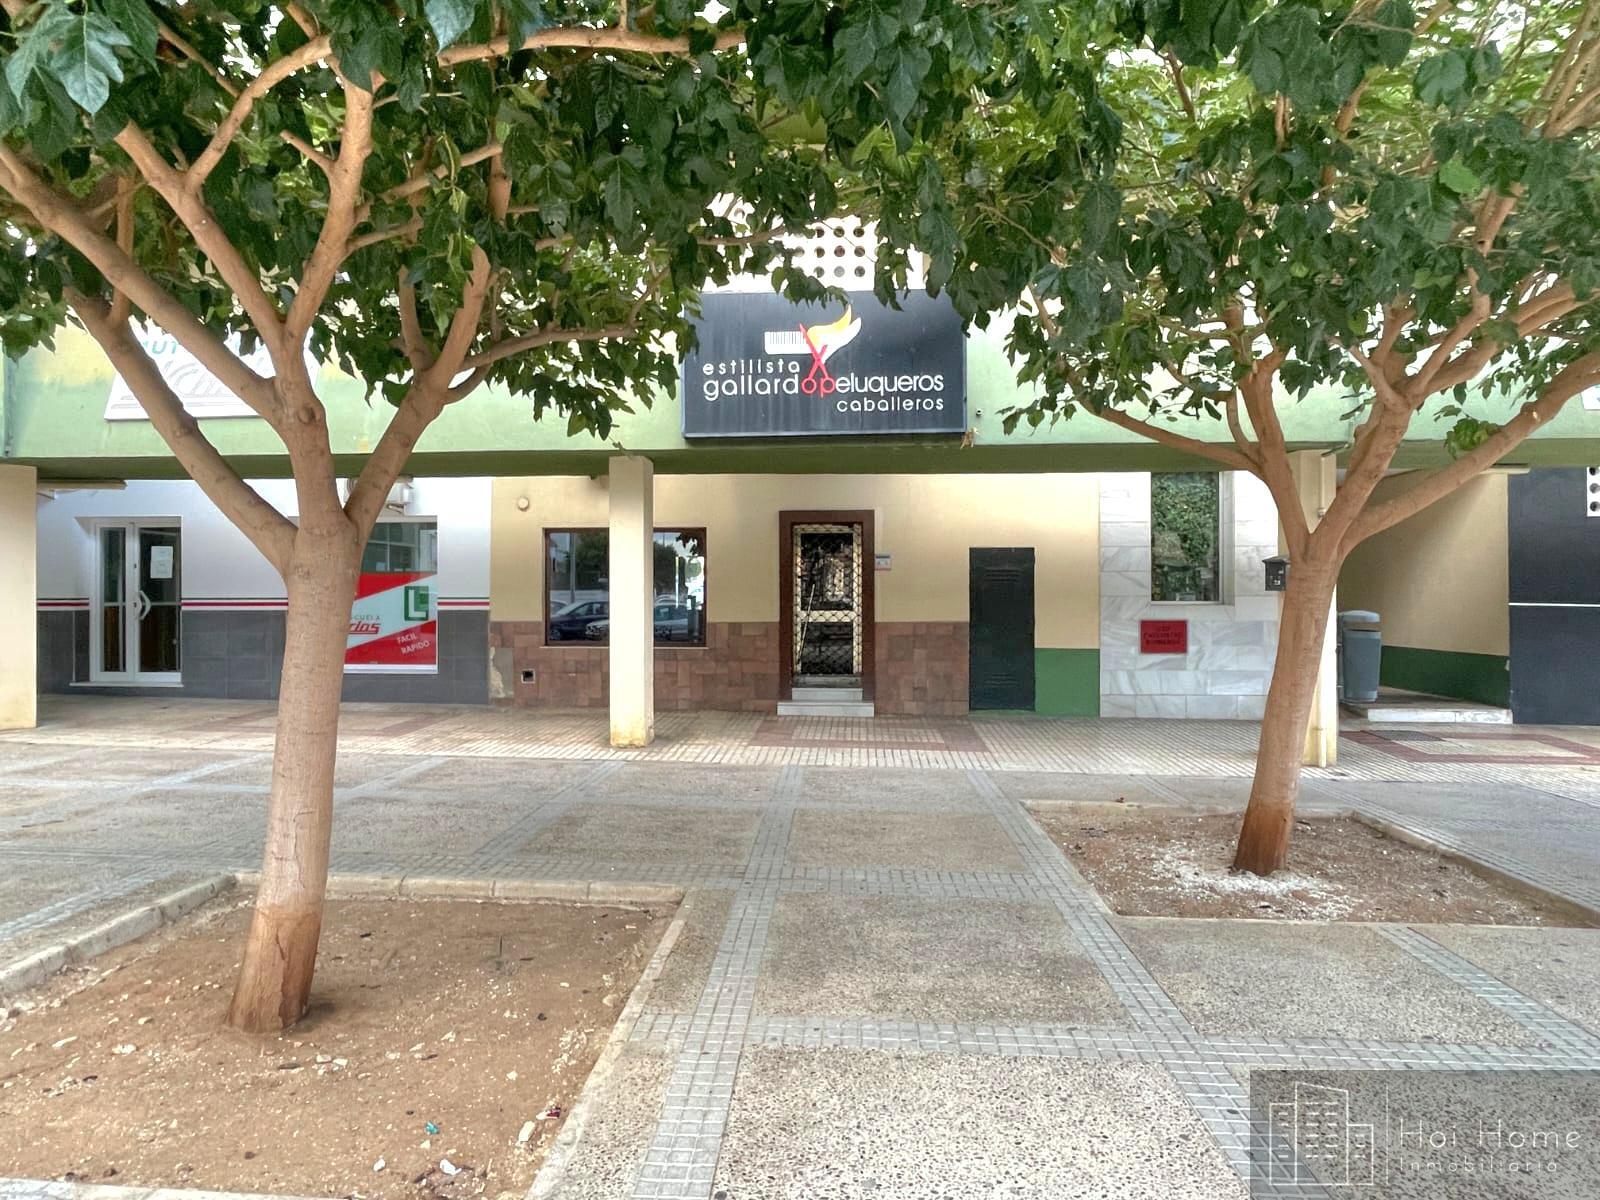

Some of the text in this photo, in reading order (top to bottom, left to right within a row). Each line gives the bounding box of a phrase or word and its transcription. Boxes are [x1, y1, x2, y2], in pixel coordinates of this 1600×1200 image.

[702, 358, 800, 375] estilista
[836, 396, 944, 412] caballeros
[400, 640, 431, 655] RAPIDO
